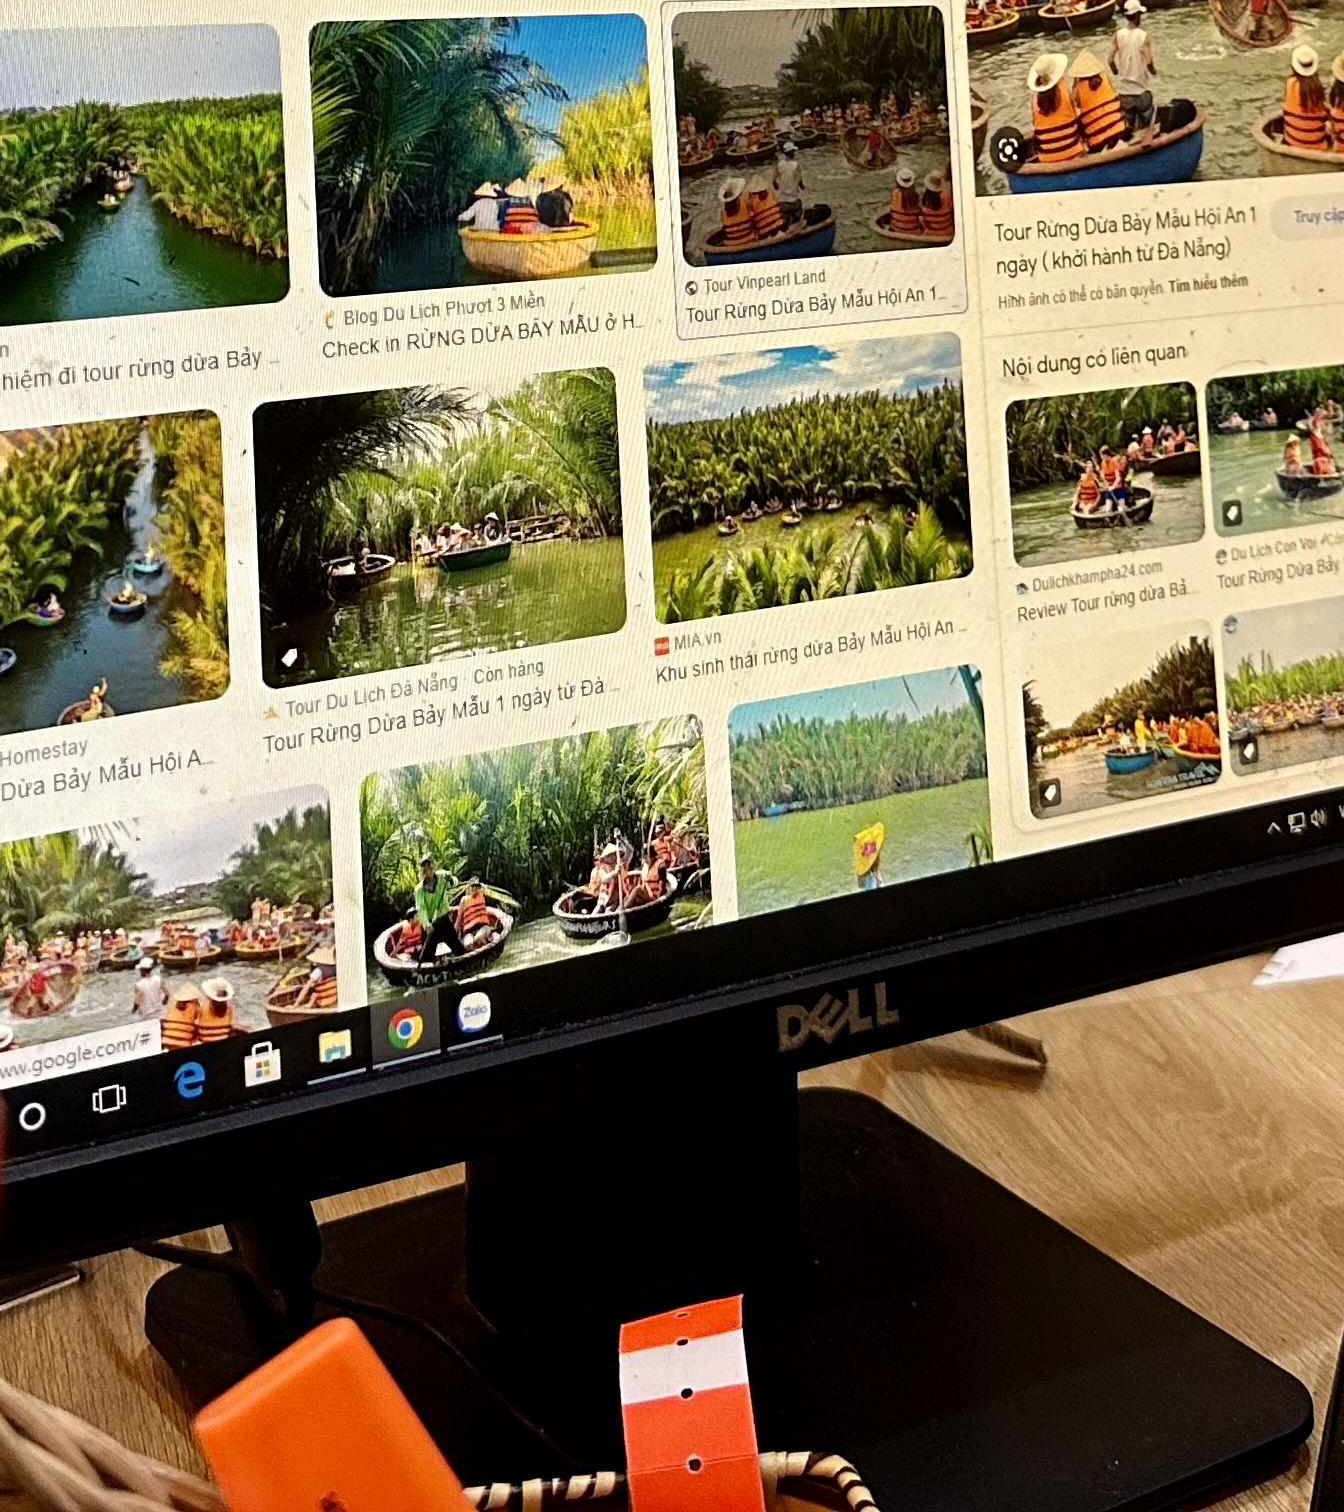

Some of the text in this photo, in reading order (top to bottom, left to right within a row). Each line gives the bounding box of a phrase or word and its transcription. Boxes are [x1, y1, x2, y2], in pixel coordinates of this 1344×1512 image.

[994, 223, 1031, 243] Tour
[1225, 207, 1245, 225] An
[1250, 206, 1257, 223] 1
[704, 268, 826, 294] Tour Vinpearl Land
[686, 306, 721, 324] Tour
[905, 288, 924, 303] An
[322, 336, 380, 359] Check
[386, 335, 400, 353] in
[1037, 353, 1080, 376] dung
[1146, 343, 1187, 364] quan
[59, 366, 76, 386] đi
[83, 361, 121, 383] tour
[656, 664, 687, 683] Khu
[692, 656, 724, 676] sinh
[934, 619, 954, 635] An
[674, 631, 722, 651] MIA.vn
[263, 731, 305, 754] Tour
[496, 695, 504, 712] 1
[0, 740, 88, 767] Homestay
[776, 982, 900, 1053] DELL
